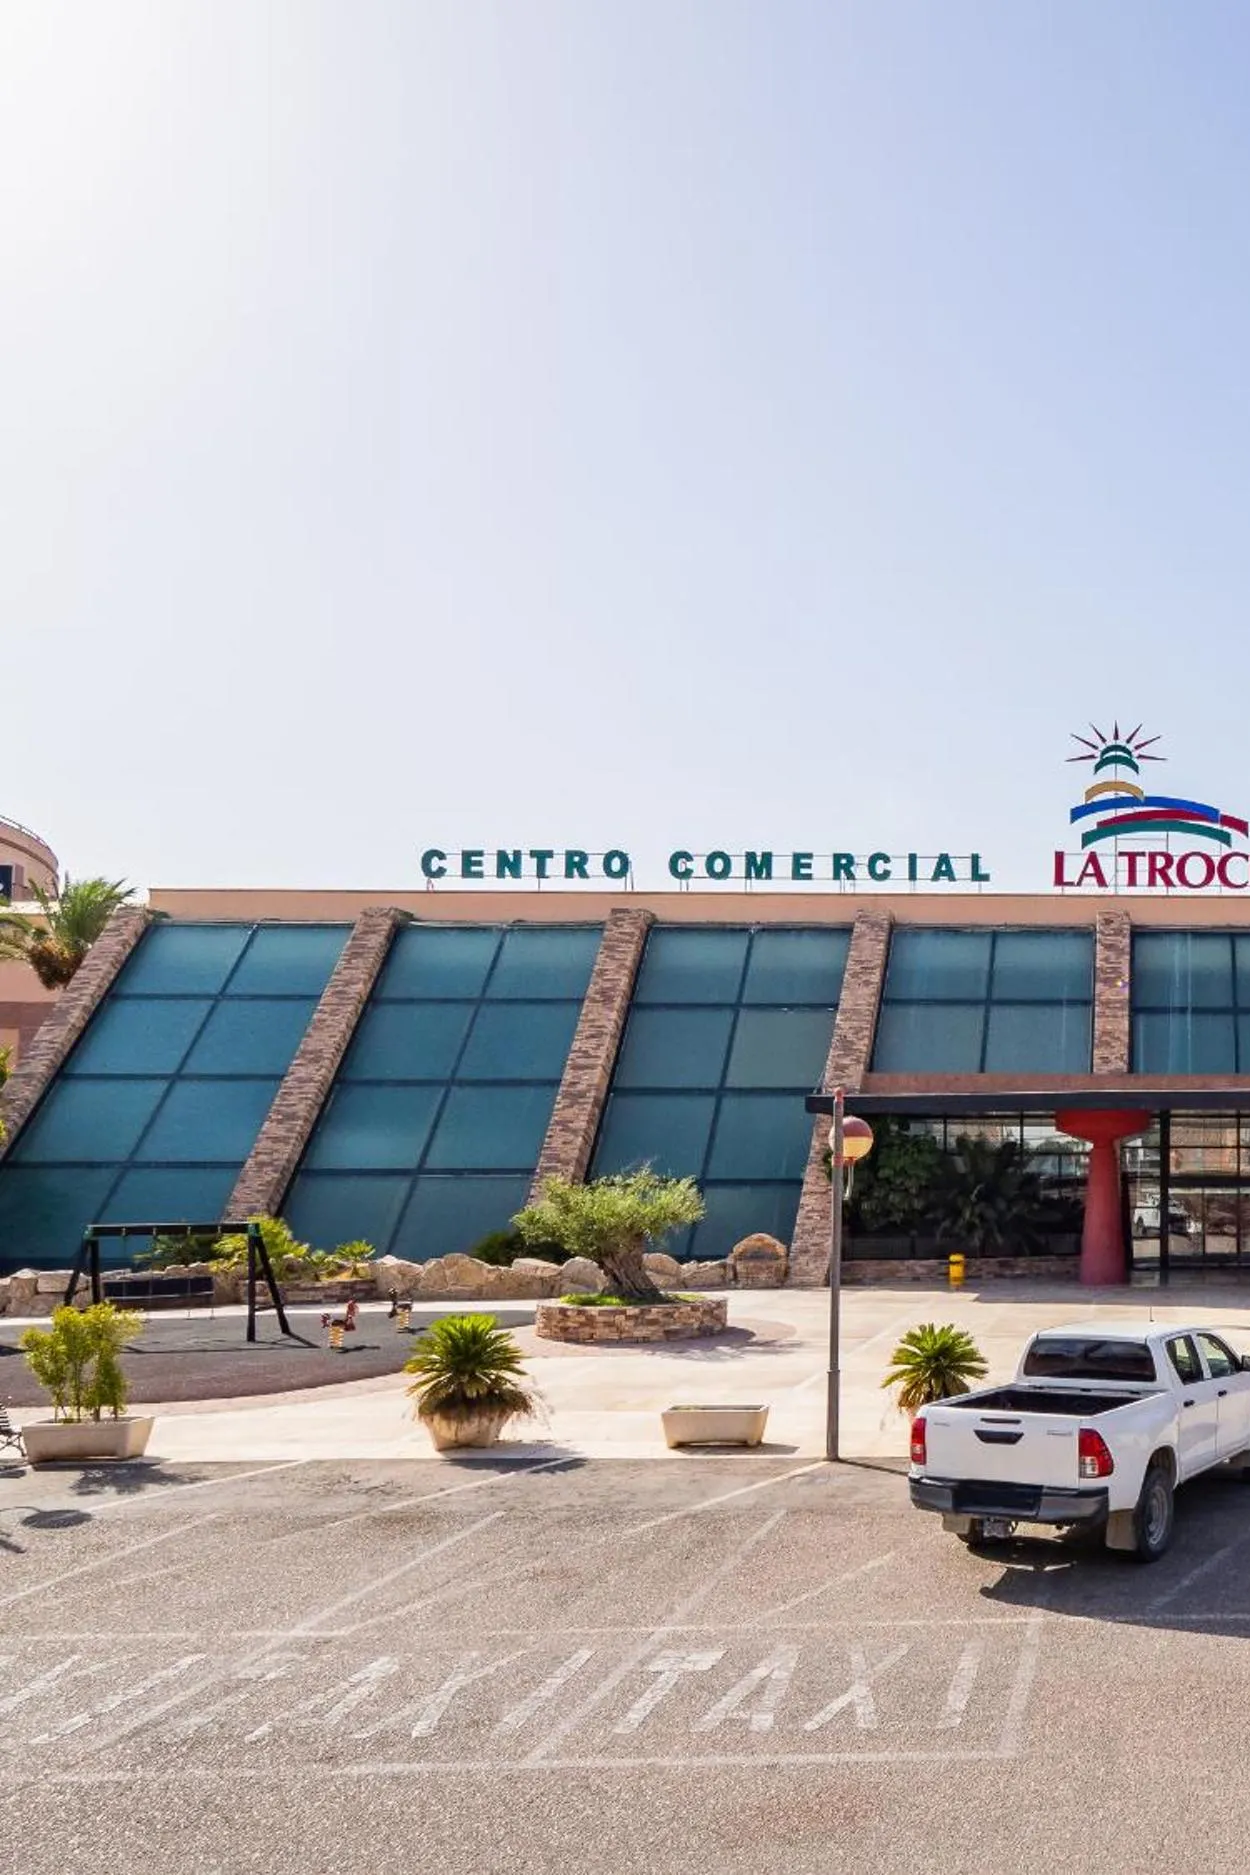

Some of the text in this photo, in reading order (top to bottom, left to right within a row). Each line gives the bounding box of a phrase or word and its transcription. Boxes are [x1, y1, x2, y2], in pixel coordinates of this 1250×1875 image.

[421, 849, 991, 882] CENTRO COMERCIAL
[1053, 851, 1109, 888] LA
[611, 1642, 986, 1734] TAXI
